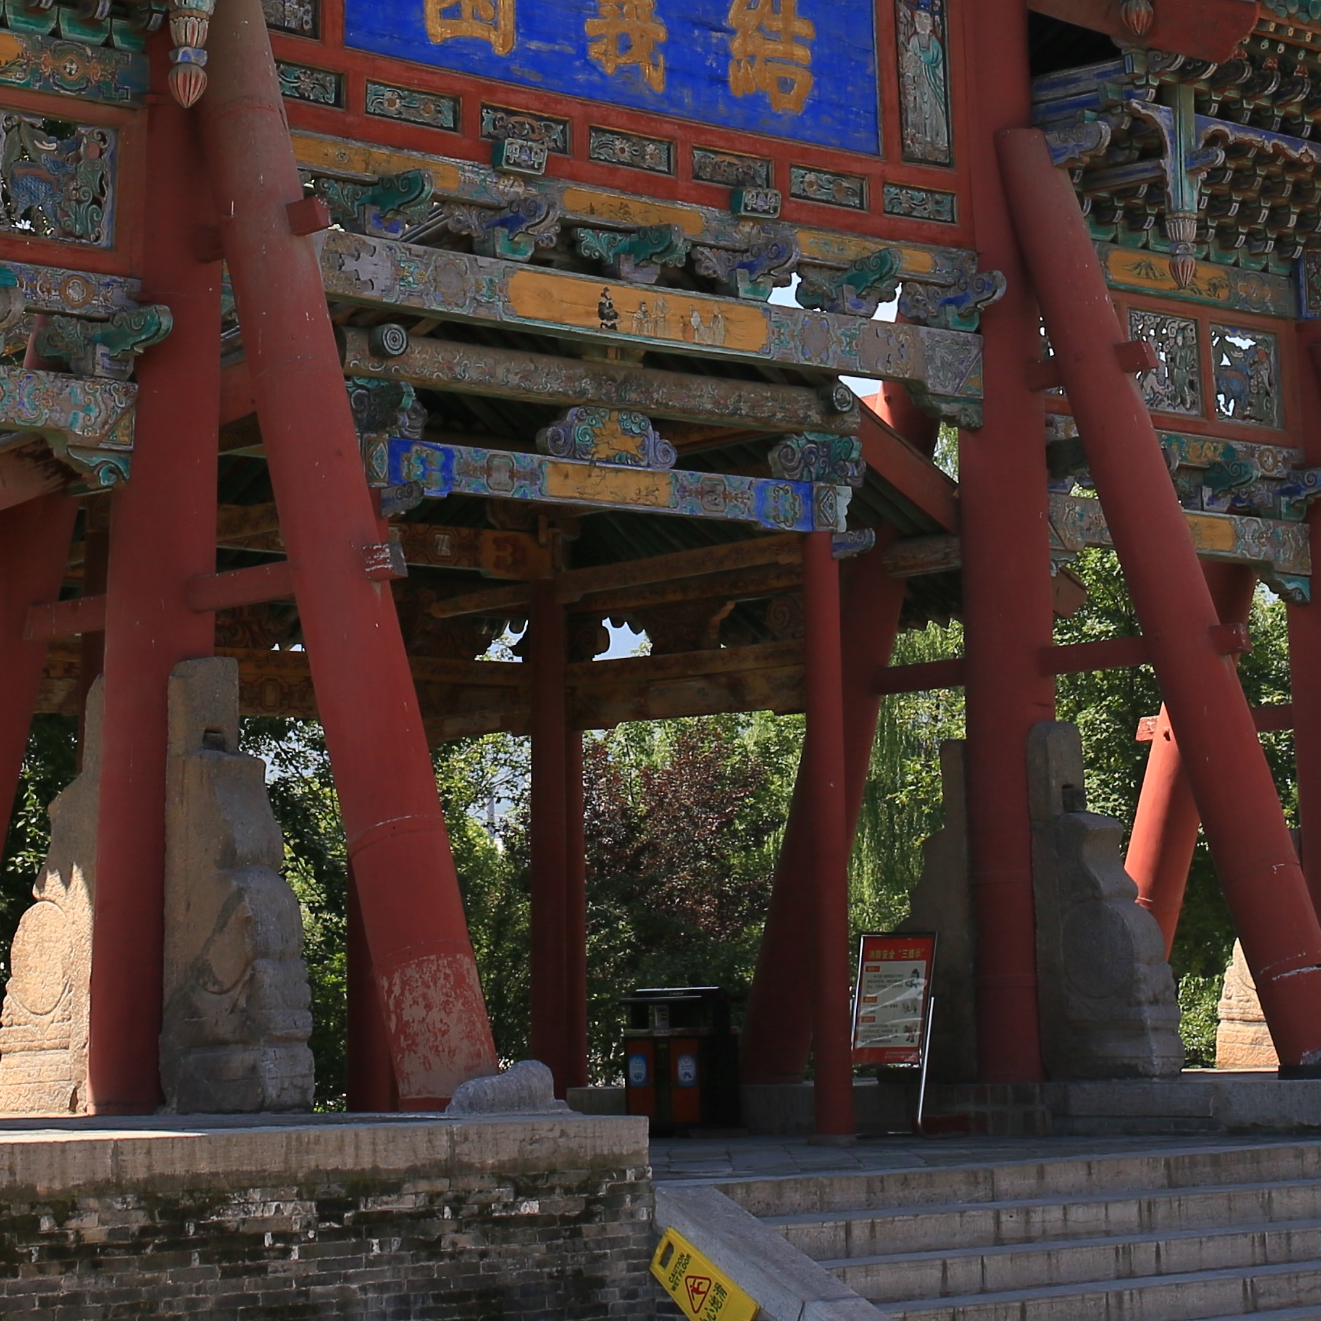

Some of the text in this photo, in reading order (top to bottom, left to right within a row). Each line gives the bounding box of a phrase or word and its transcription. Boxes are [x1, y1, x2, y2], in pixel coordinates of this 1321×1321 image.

[669, 1253, 685, 1283] CAUTION
[671, 1253, 692, 1292] WET FLOOR
